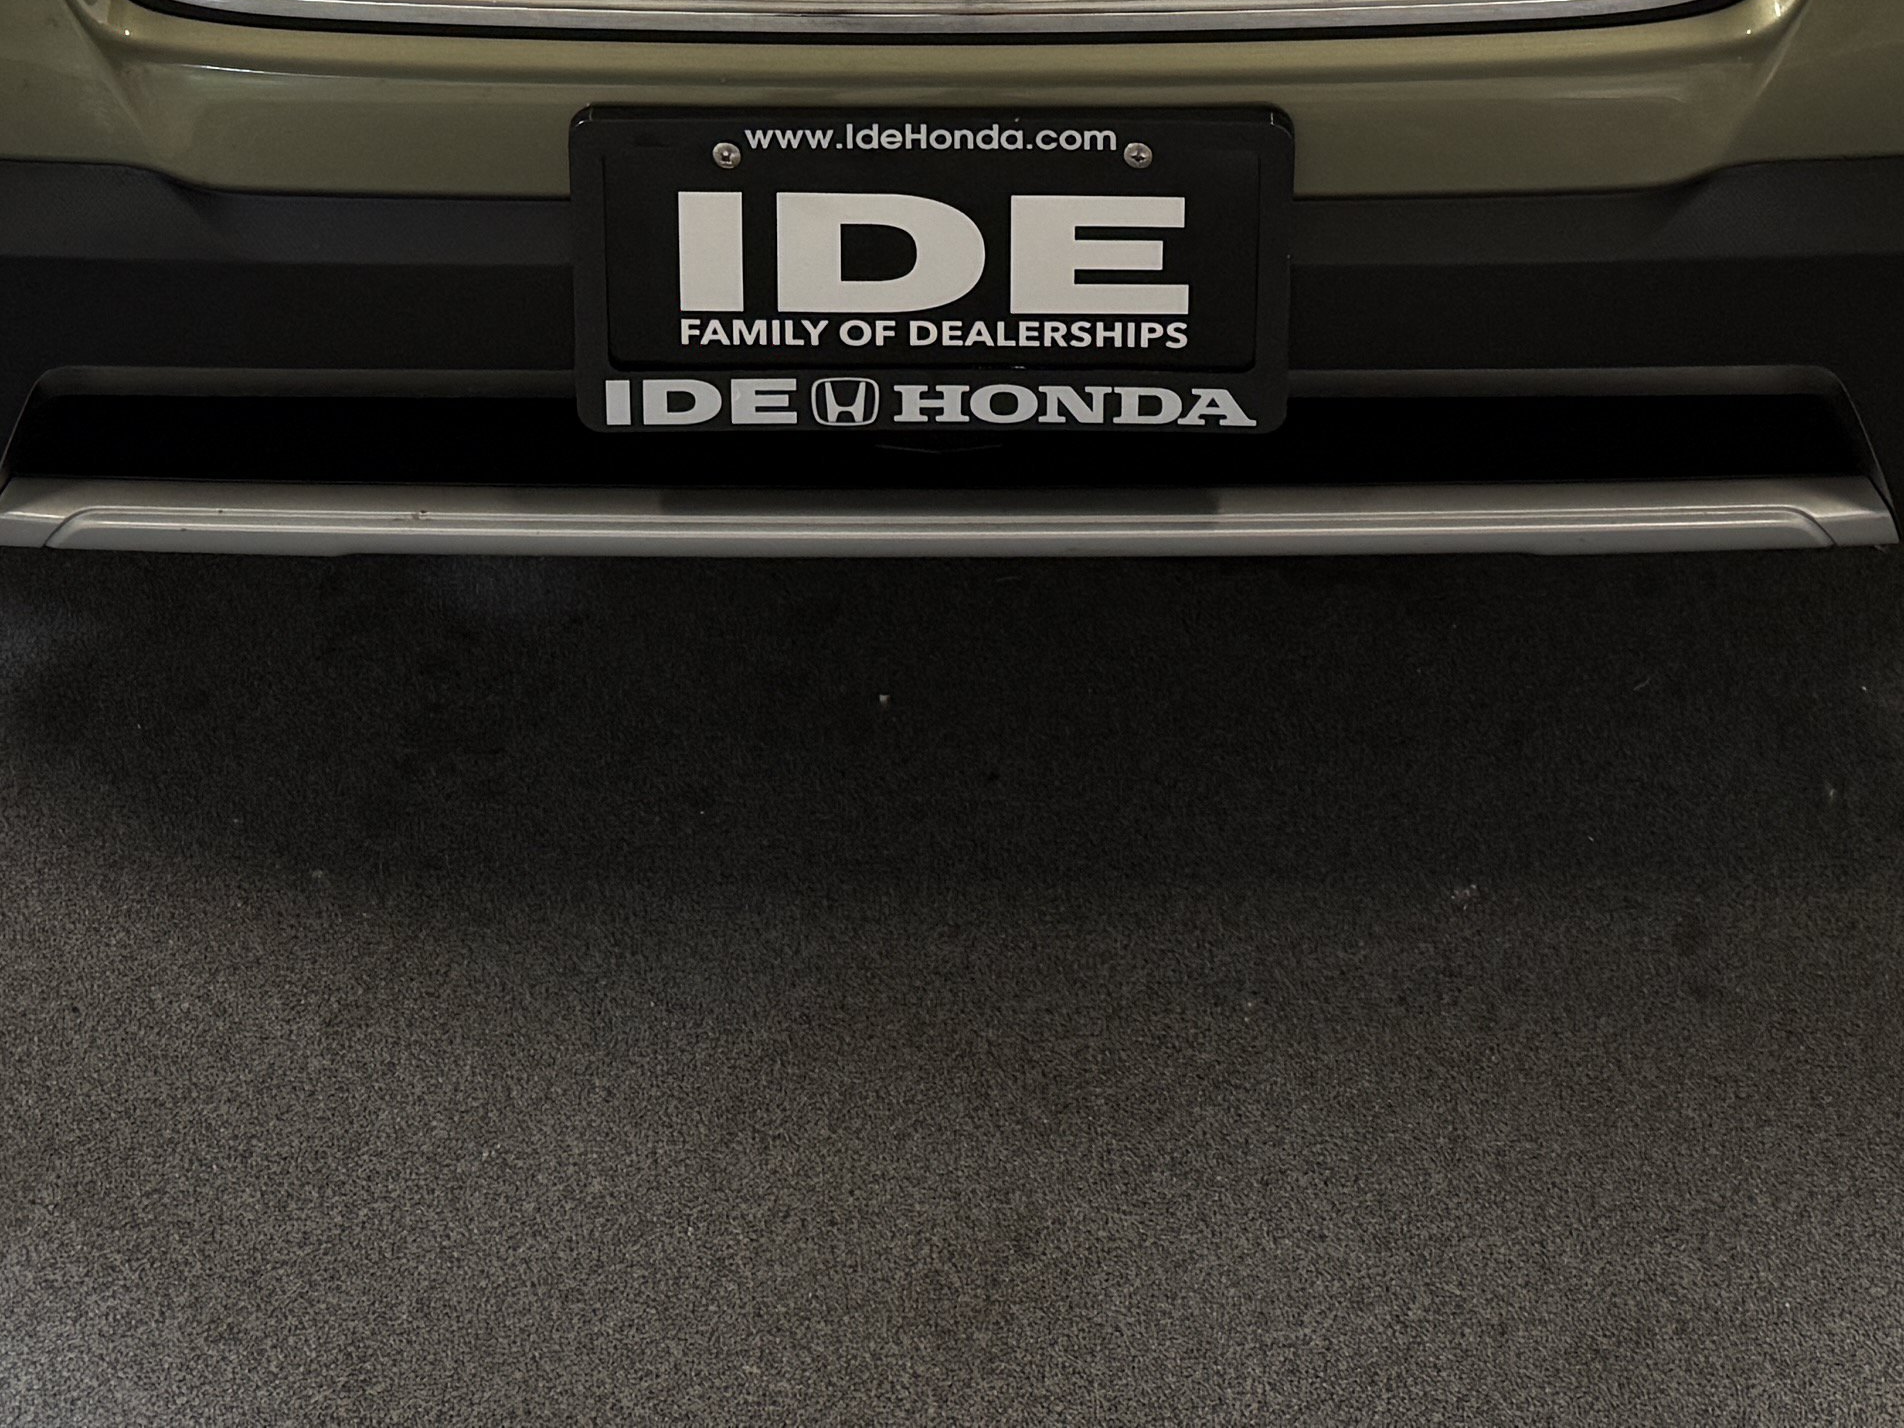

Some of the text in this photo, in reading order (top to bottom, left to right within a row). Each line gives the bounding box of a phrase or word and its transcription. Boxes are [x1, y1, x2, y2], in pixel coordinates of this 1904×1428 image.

[744, 124, 1117, 151] www.IdeHonda.com
[678, 191, 1190, 315] IDE
[681, 319, 1188, 349] FAMILY OF DEALERSHIPS
[605, 378, 798, 426] IDE
[893, 385, 1257, 427] HONDA
